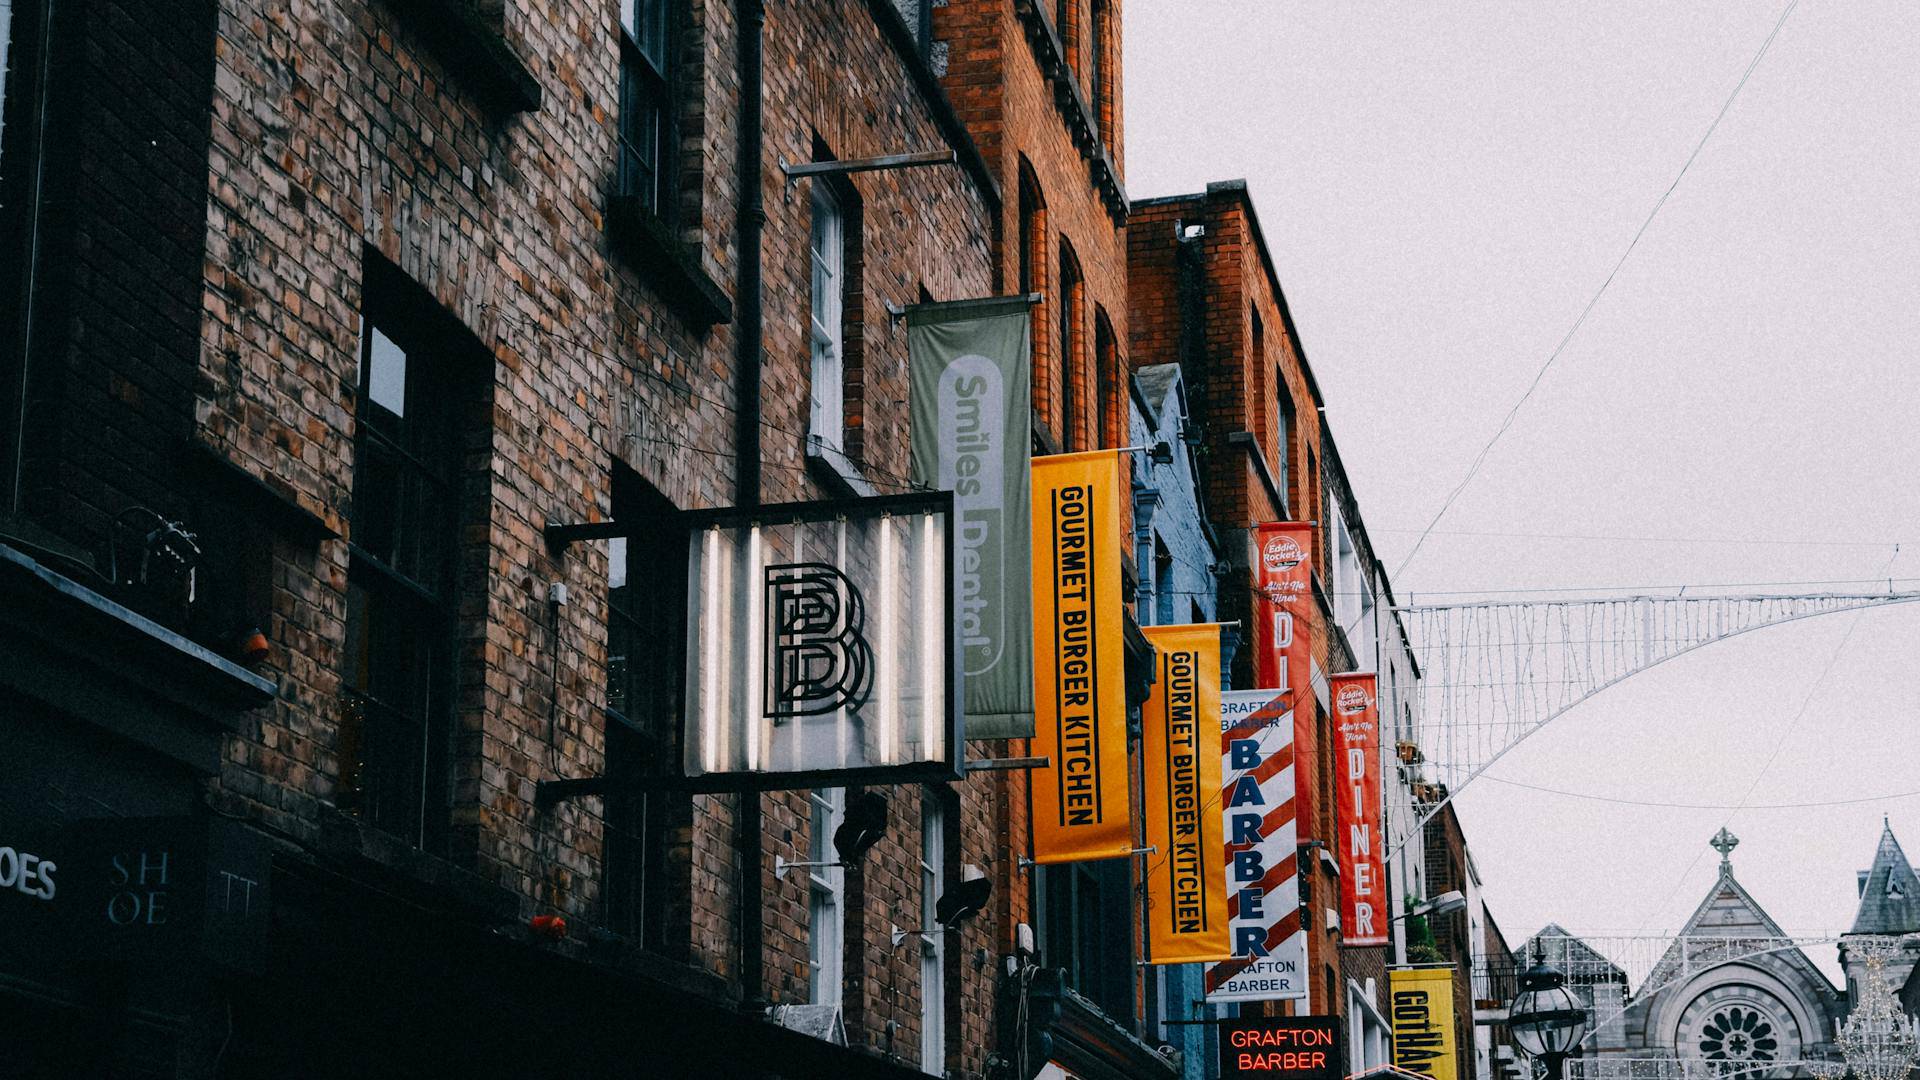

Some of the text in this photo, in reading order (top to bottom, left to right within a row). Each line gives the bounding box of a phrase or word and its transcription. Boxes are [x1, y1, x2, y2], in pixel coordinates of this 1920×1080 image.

[955, 375, 990, 496] Smiles
[764, 562, 868, 720] B
[1061, 486, 1093, 826] GOURMET BURGER KITCHEN
[1171, 651, 1200, 933] GOURMET BURGER KITCHEN
[1230, 739, 1270, 957] BARBER
[1348, 748, 1374, 935] DINER
[1228, 979, 1290, 992] BARBER
[1231, 961, 1296, 975] AFTON
[1231, 1028, 1333, 1048] GRAFTON
[1238, 1052, 1326, 1070] BARBER
